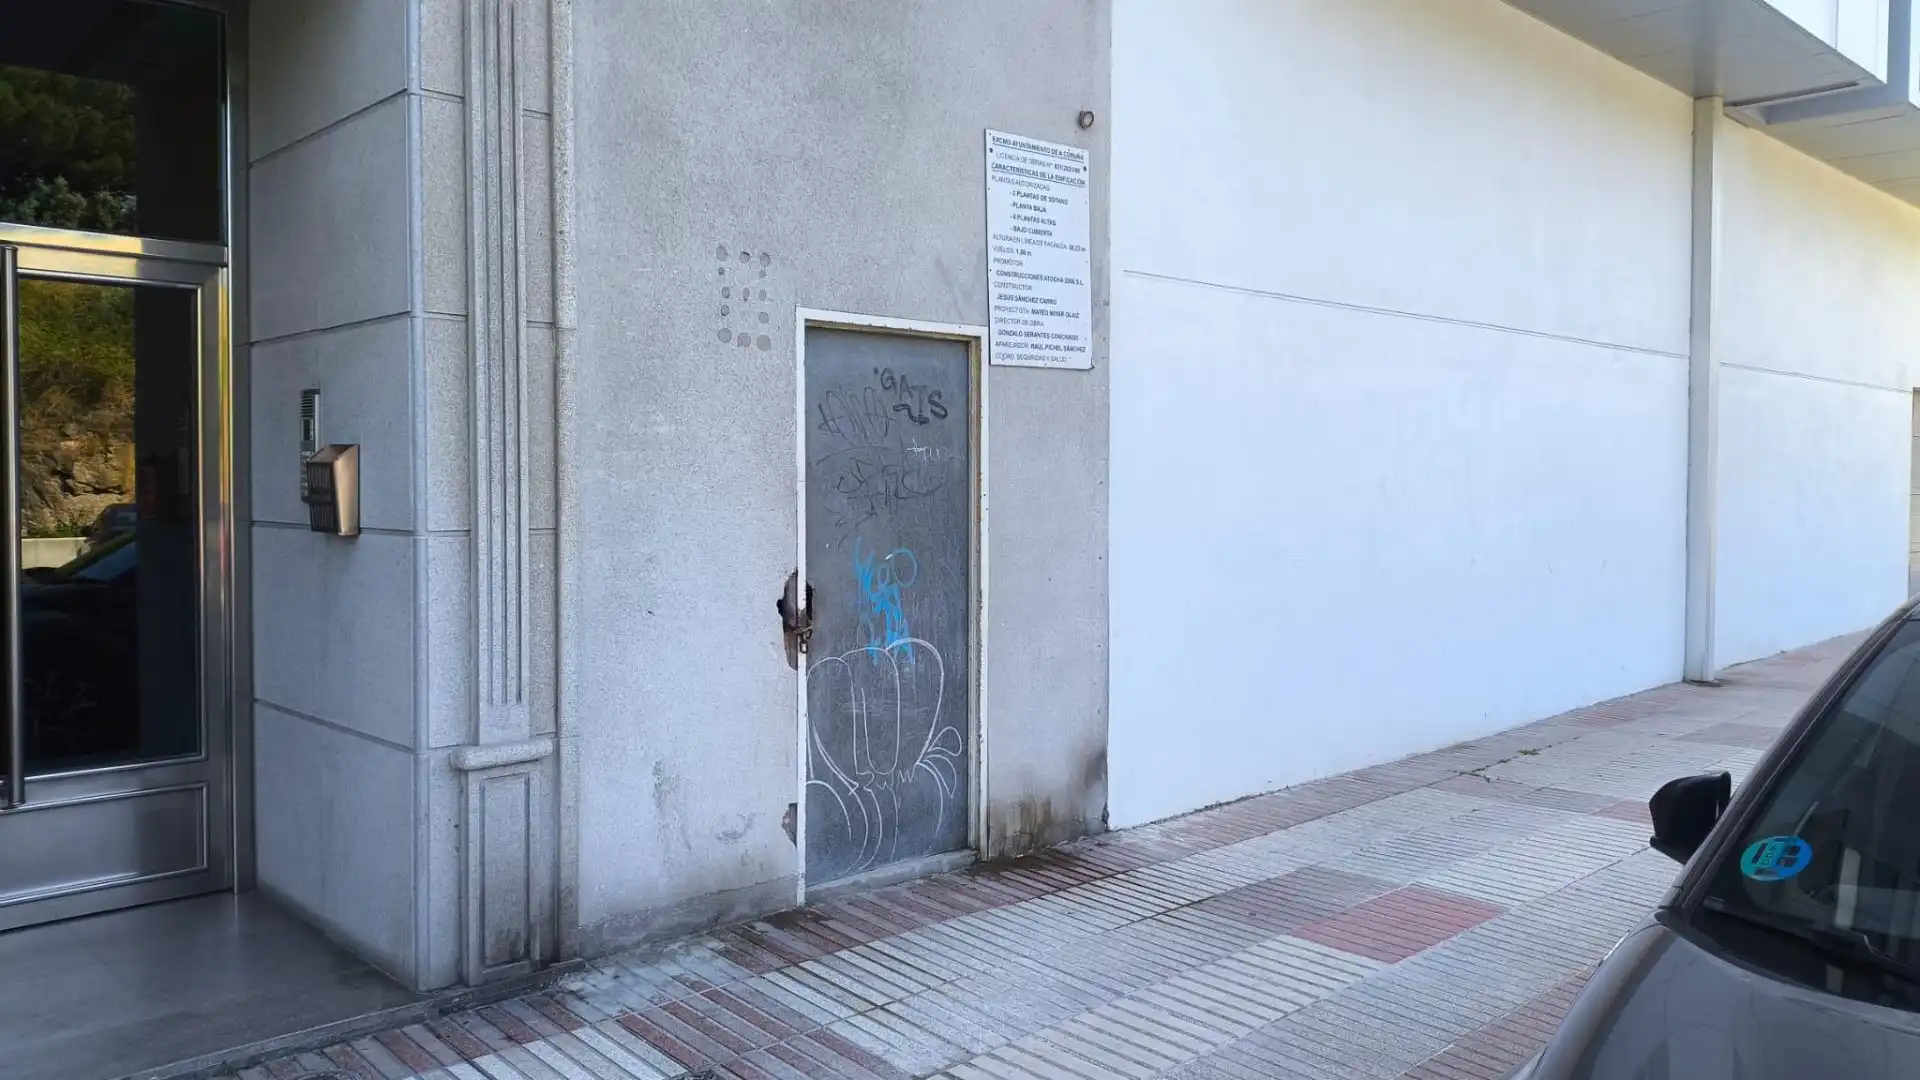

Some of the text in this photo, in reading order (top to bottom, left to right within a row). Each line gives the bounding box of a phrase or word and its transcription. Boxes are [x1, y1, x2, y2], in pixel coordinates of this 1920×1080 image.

[1012, 140, 1050, 153] AYUNTAMIENTO
[996, 152, 1019, 161] LICENCIA
[1029, 158, 1045, 167] OBRAS
[992, 175, 1013, 184] PLANTAS
[1017, 191, 1039, 200] PLANTAS
[1017, 214, 1040, 223] PLANTAS
[1028, 227, 1052, 236] CUBIERTA
[996, 270, 1043, 280] CONSTRUCCIONES
